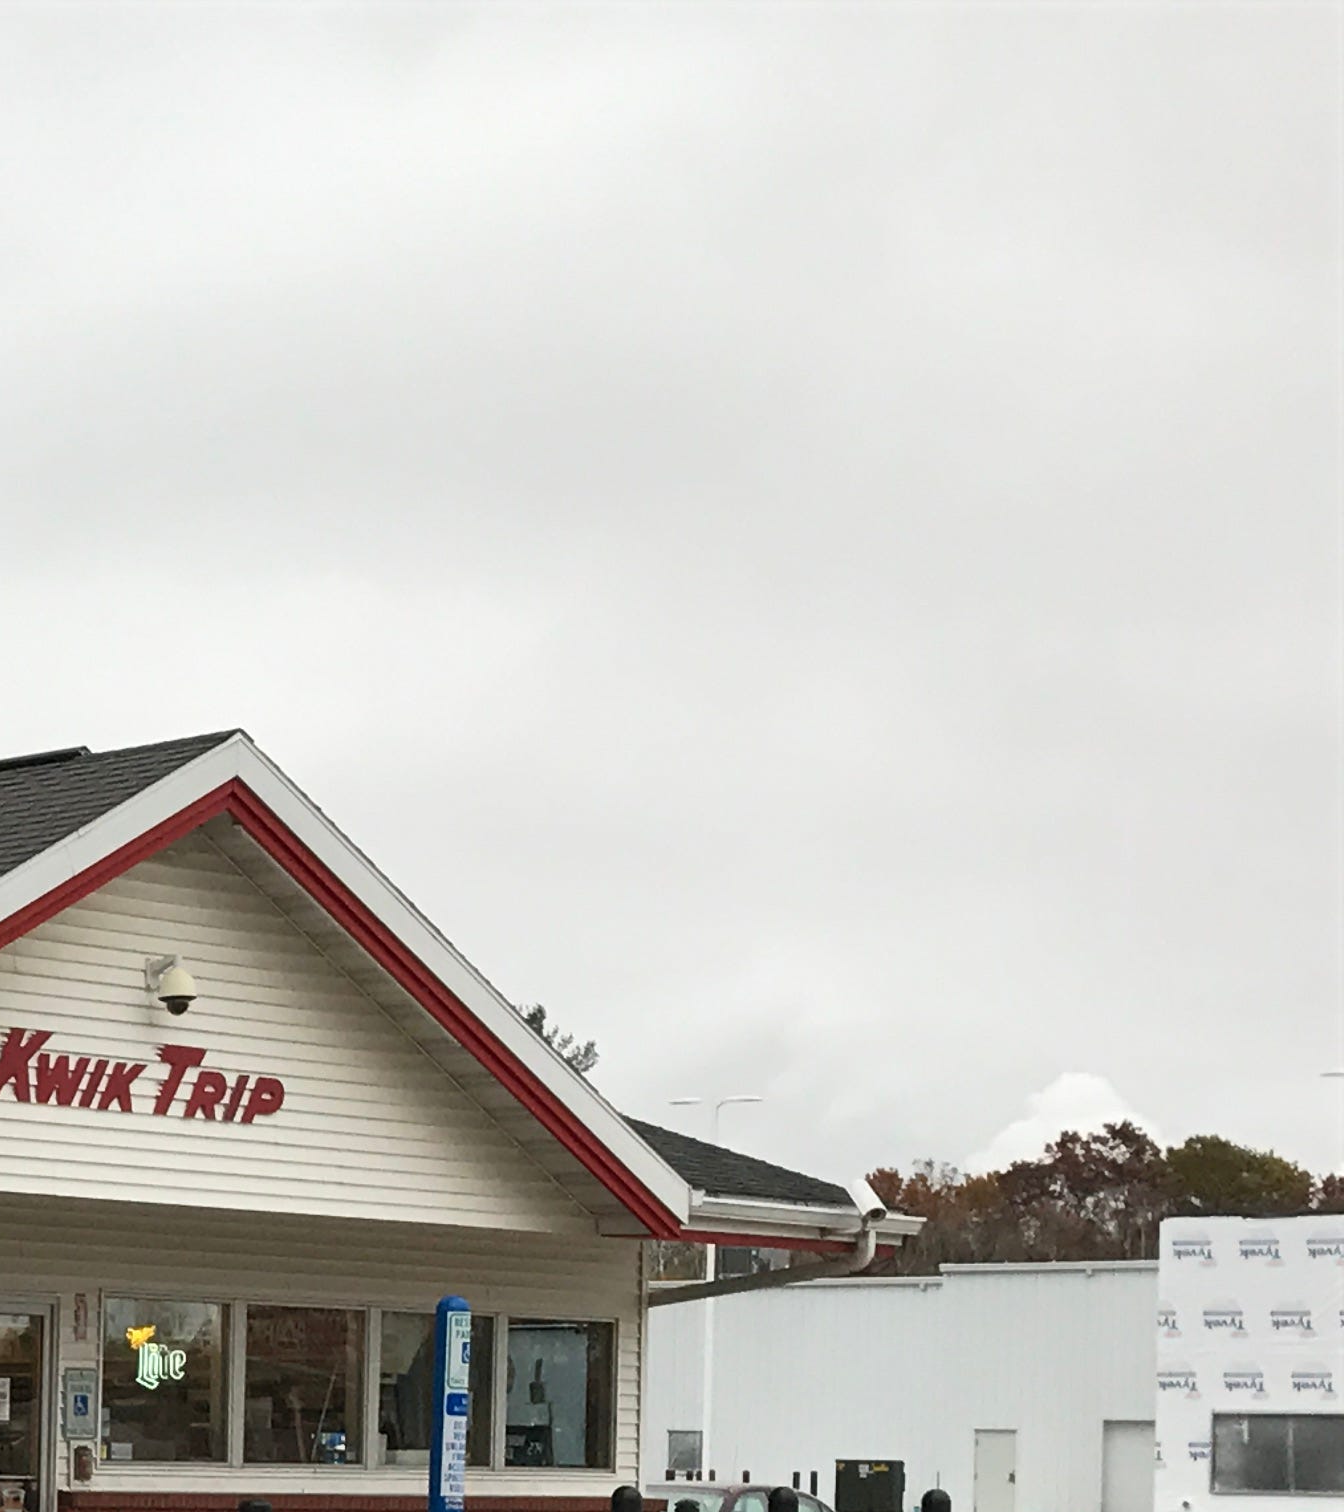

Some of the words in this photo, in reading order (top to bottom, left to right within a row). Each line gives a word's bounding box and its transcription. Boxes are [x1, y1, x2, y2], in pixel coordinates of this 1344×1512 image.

[153, 1043, 286, 1125] TRIP
[1239, 1246, 1281, 1260] Tyvek
[1272, 1316, 1313, 1330] Tyvek
[136, 1342, 187, 1390] Lite
[1224, 1378, 1265, 1392] Tyvek
[1292, 1378, 1334, 1392] Tyvek
